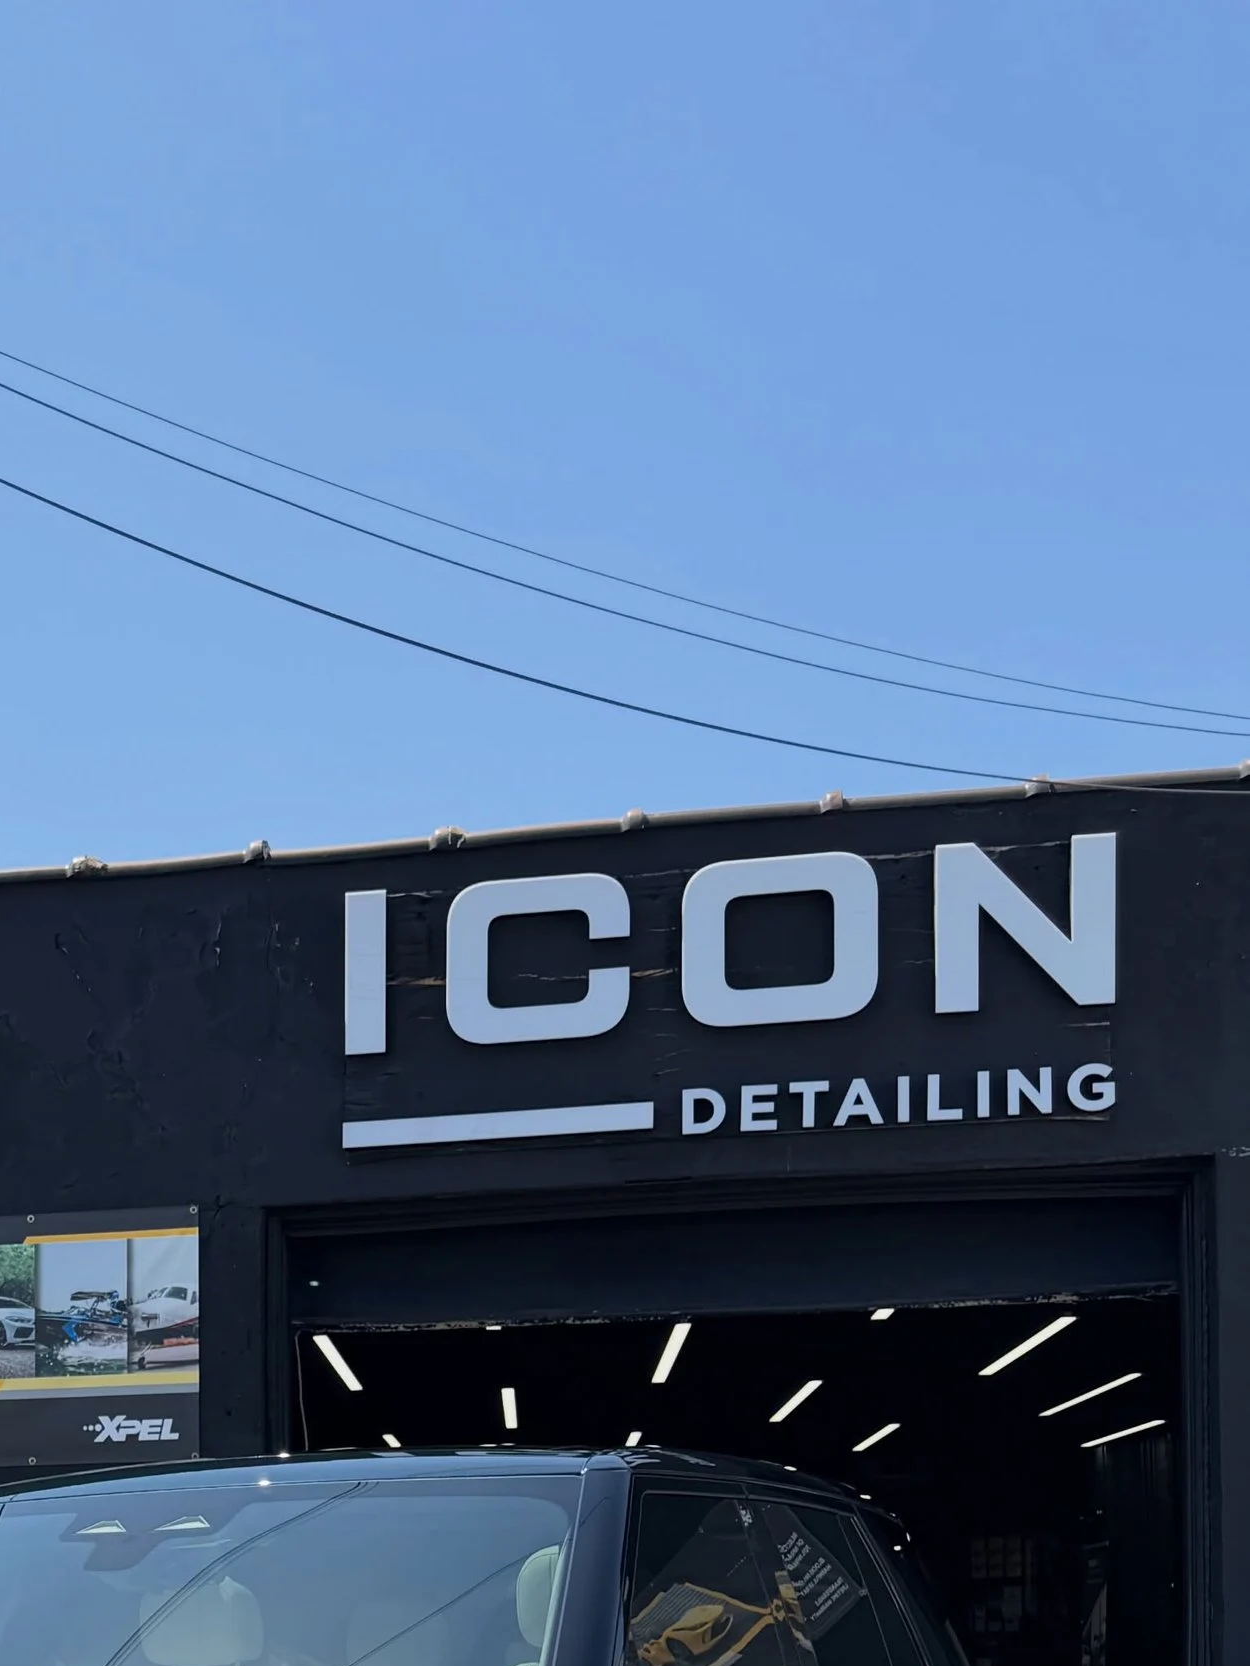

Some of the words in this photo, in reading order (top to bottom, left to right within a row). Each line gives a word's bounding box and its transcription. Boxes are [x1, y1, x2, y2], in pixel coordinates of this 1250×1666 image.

[345, 832, 1116, 1056] ICON
[682, 1062, 1116, 1135] DETAILING
[94, 1415, 179, 1443] XPEL
